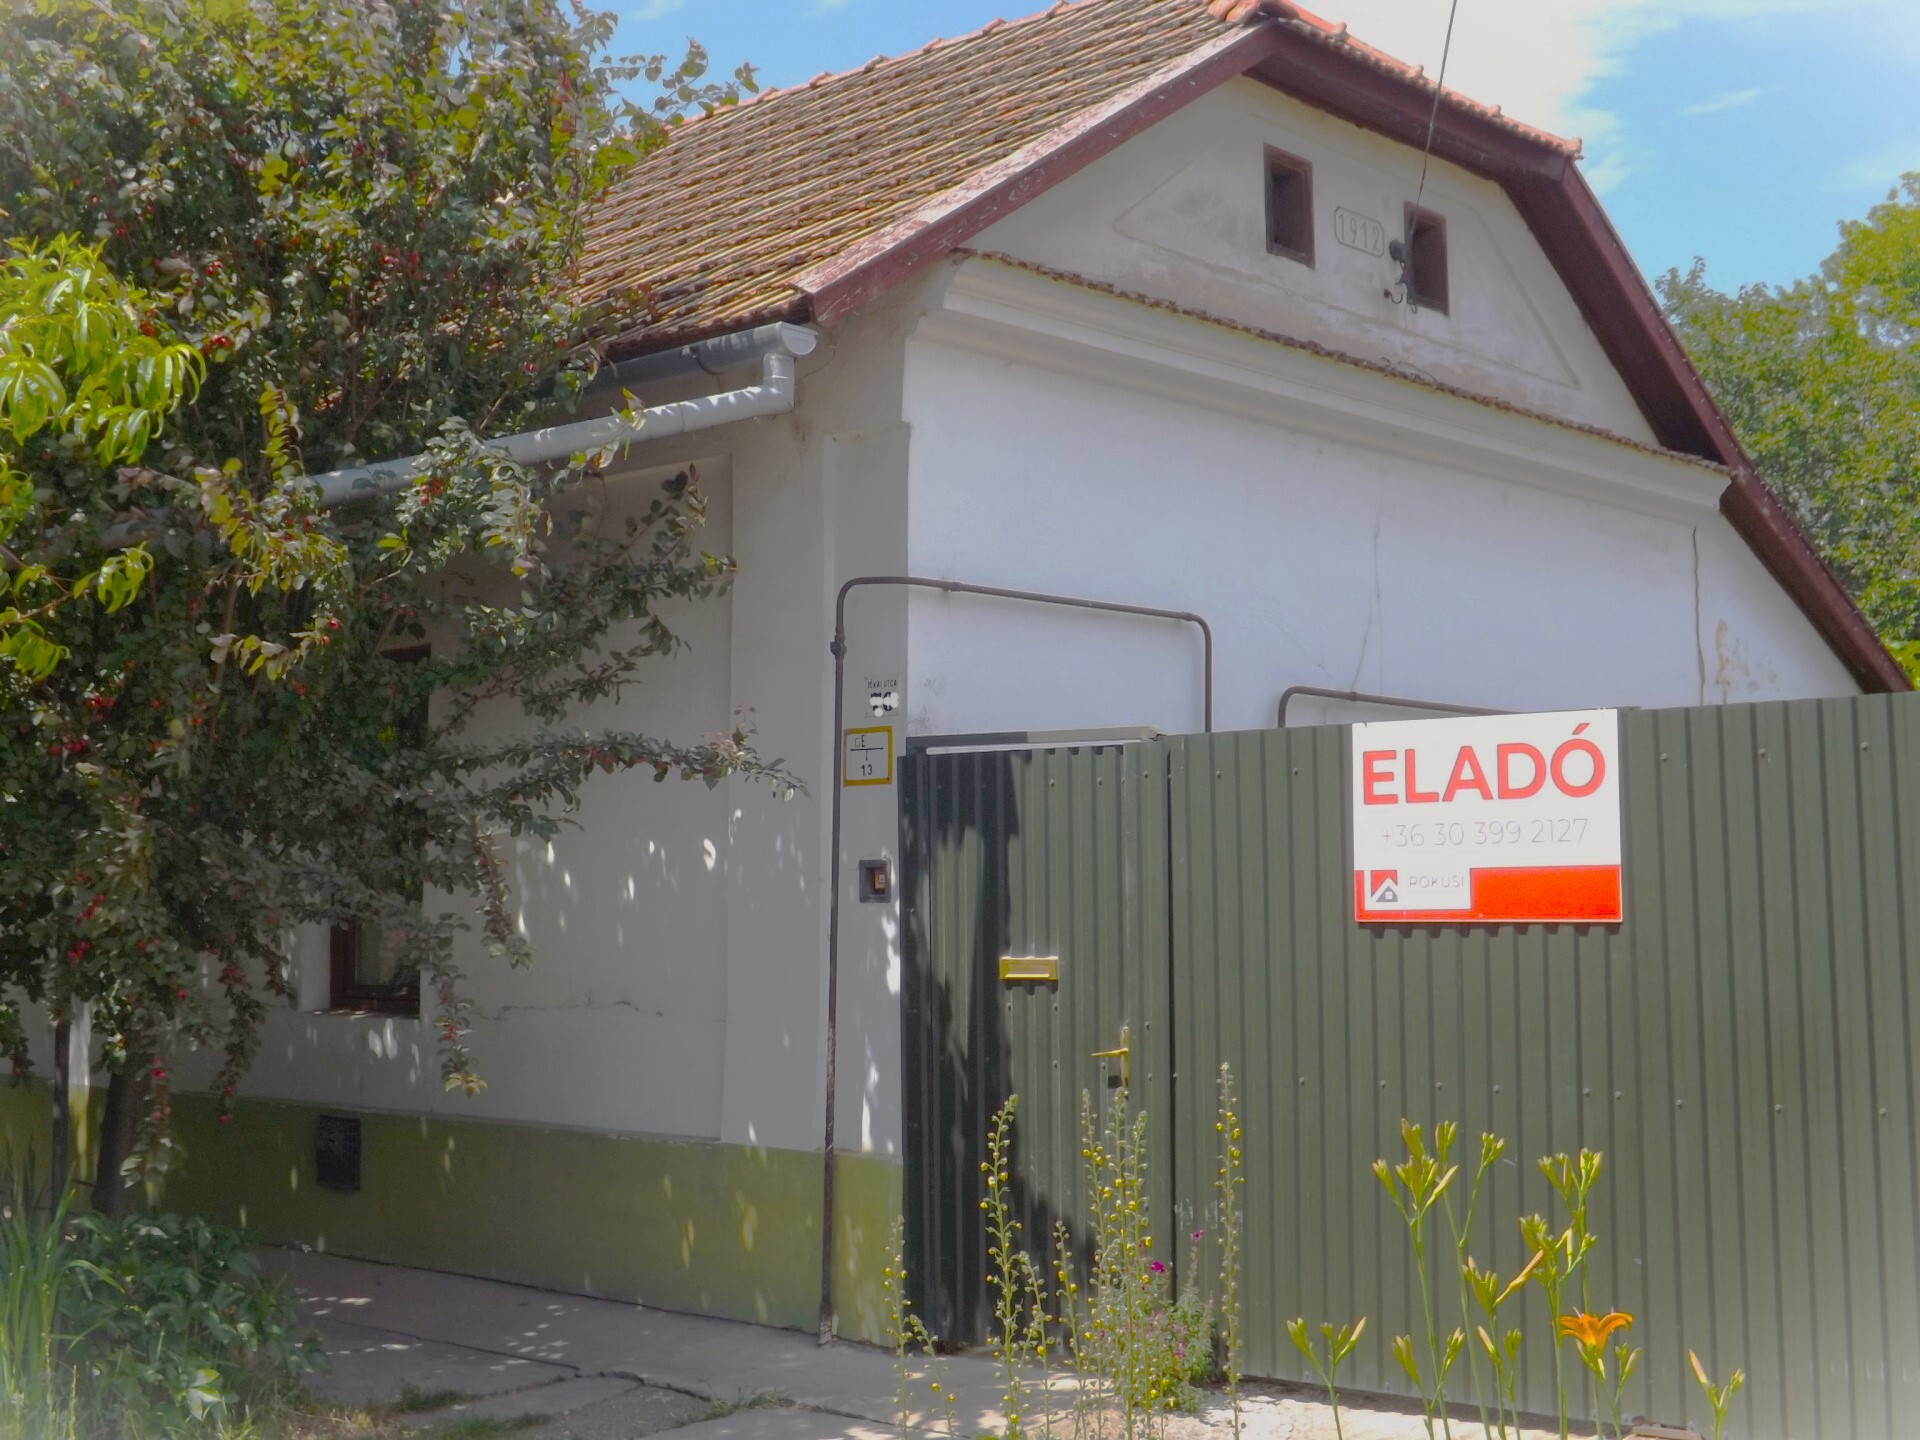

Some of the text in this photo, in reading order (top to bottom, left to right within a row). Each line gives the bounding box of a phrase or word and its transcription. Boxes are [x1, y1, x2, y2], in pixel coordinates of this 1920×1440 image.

[1338, 213, 1381, 254] 1912
[883, 680, 897, 688] UTCA
[861, 764, 873, 776] 13
[1363, 723, 1606, 805] ELADÓ
[1383, 818, 1588, 847] +36 30 399 2127
